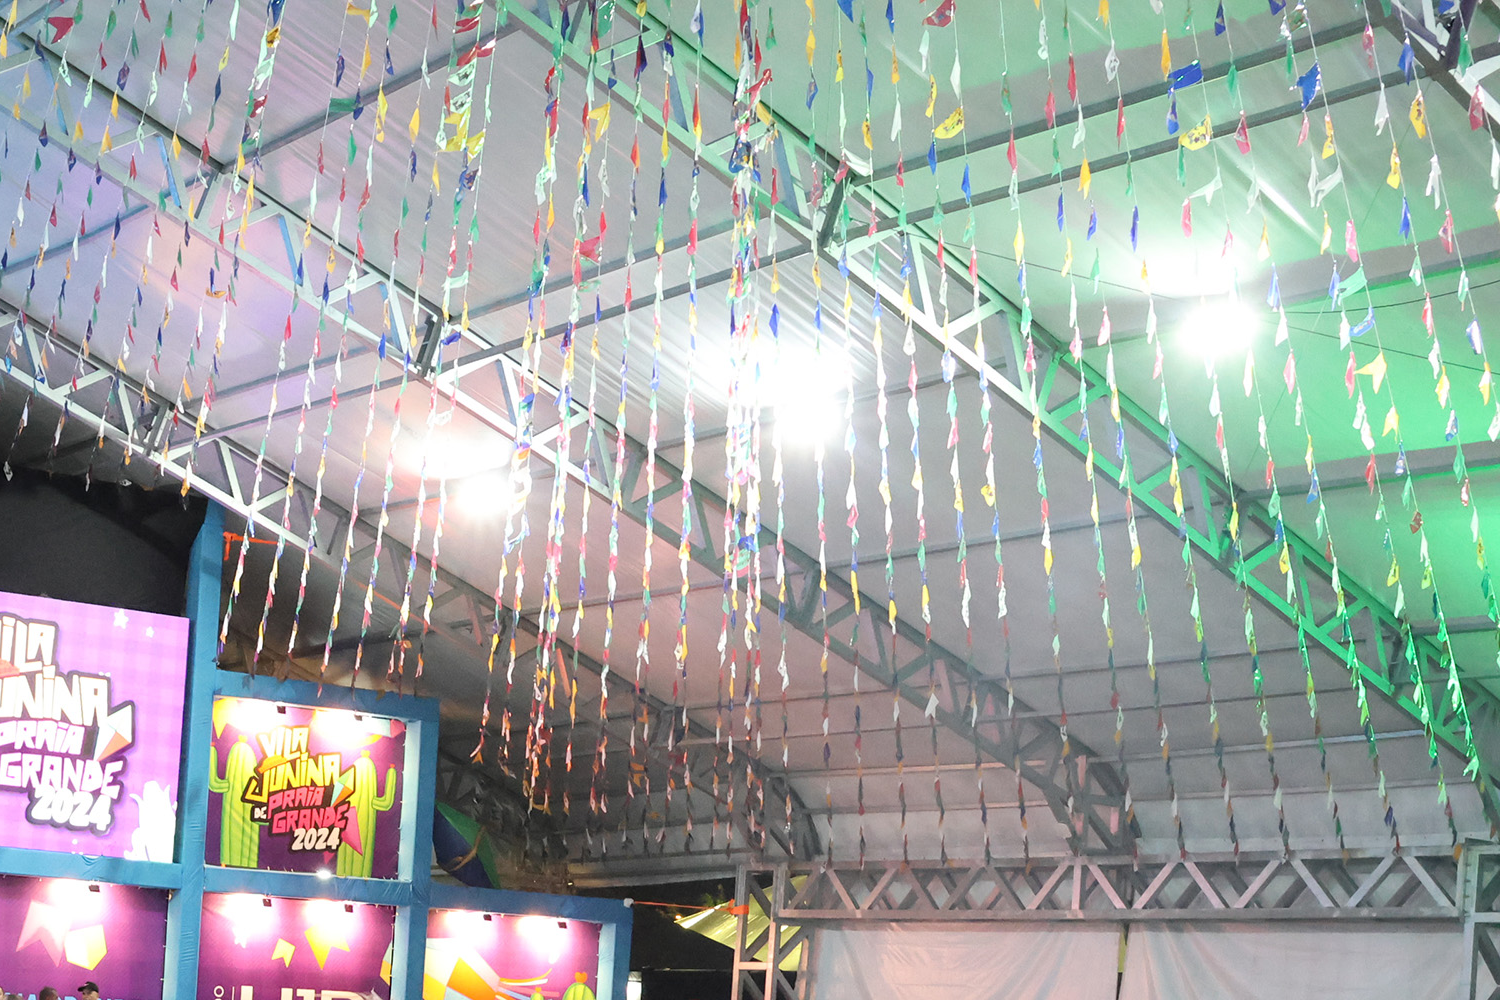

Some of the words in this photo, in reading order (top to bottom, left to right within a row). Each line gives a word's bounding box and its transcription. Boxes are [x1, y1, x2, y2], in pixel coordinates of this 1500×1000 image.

[30, 787, 113, 832] 2024
[253, 805, 268, 819] DE
[271, 803, 350, 834] GRANDE
[291, 827, 340, 851] 2024
